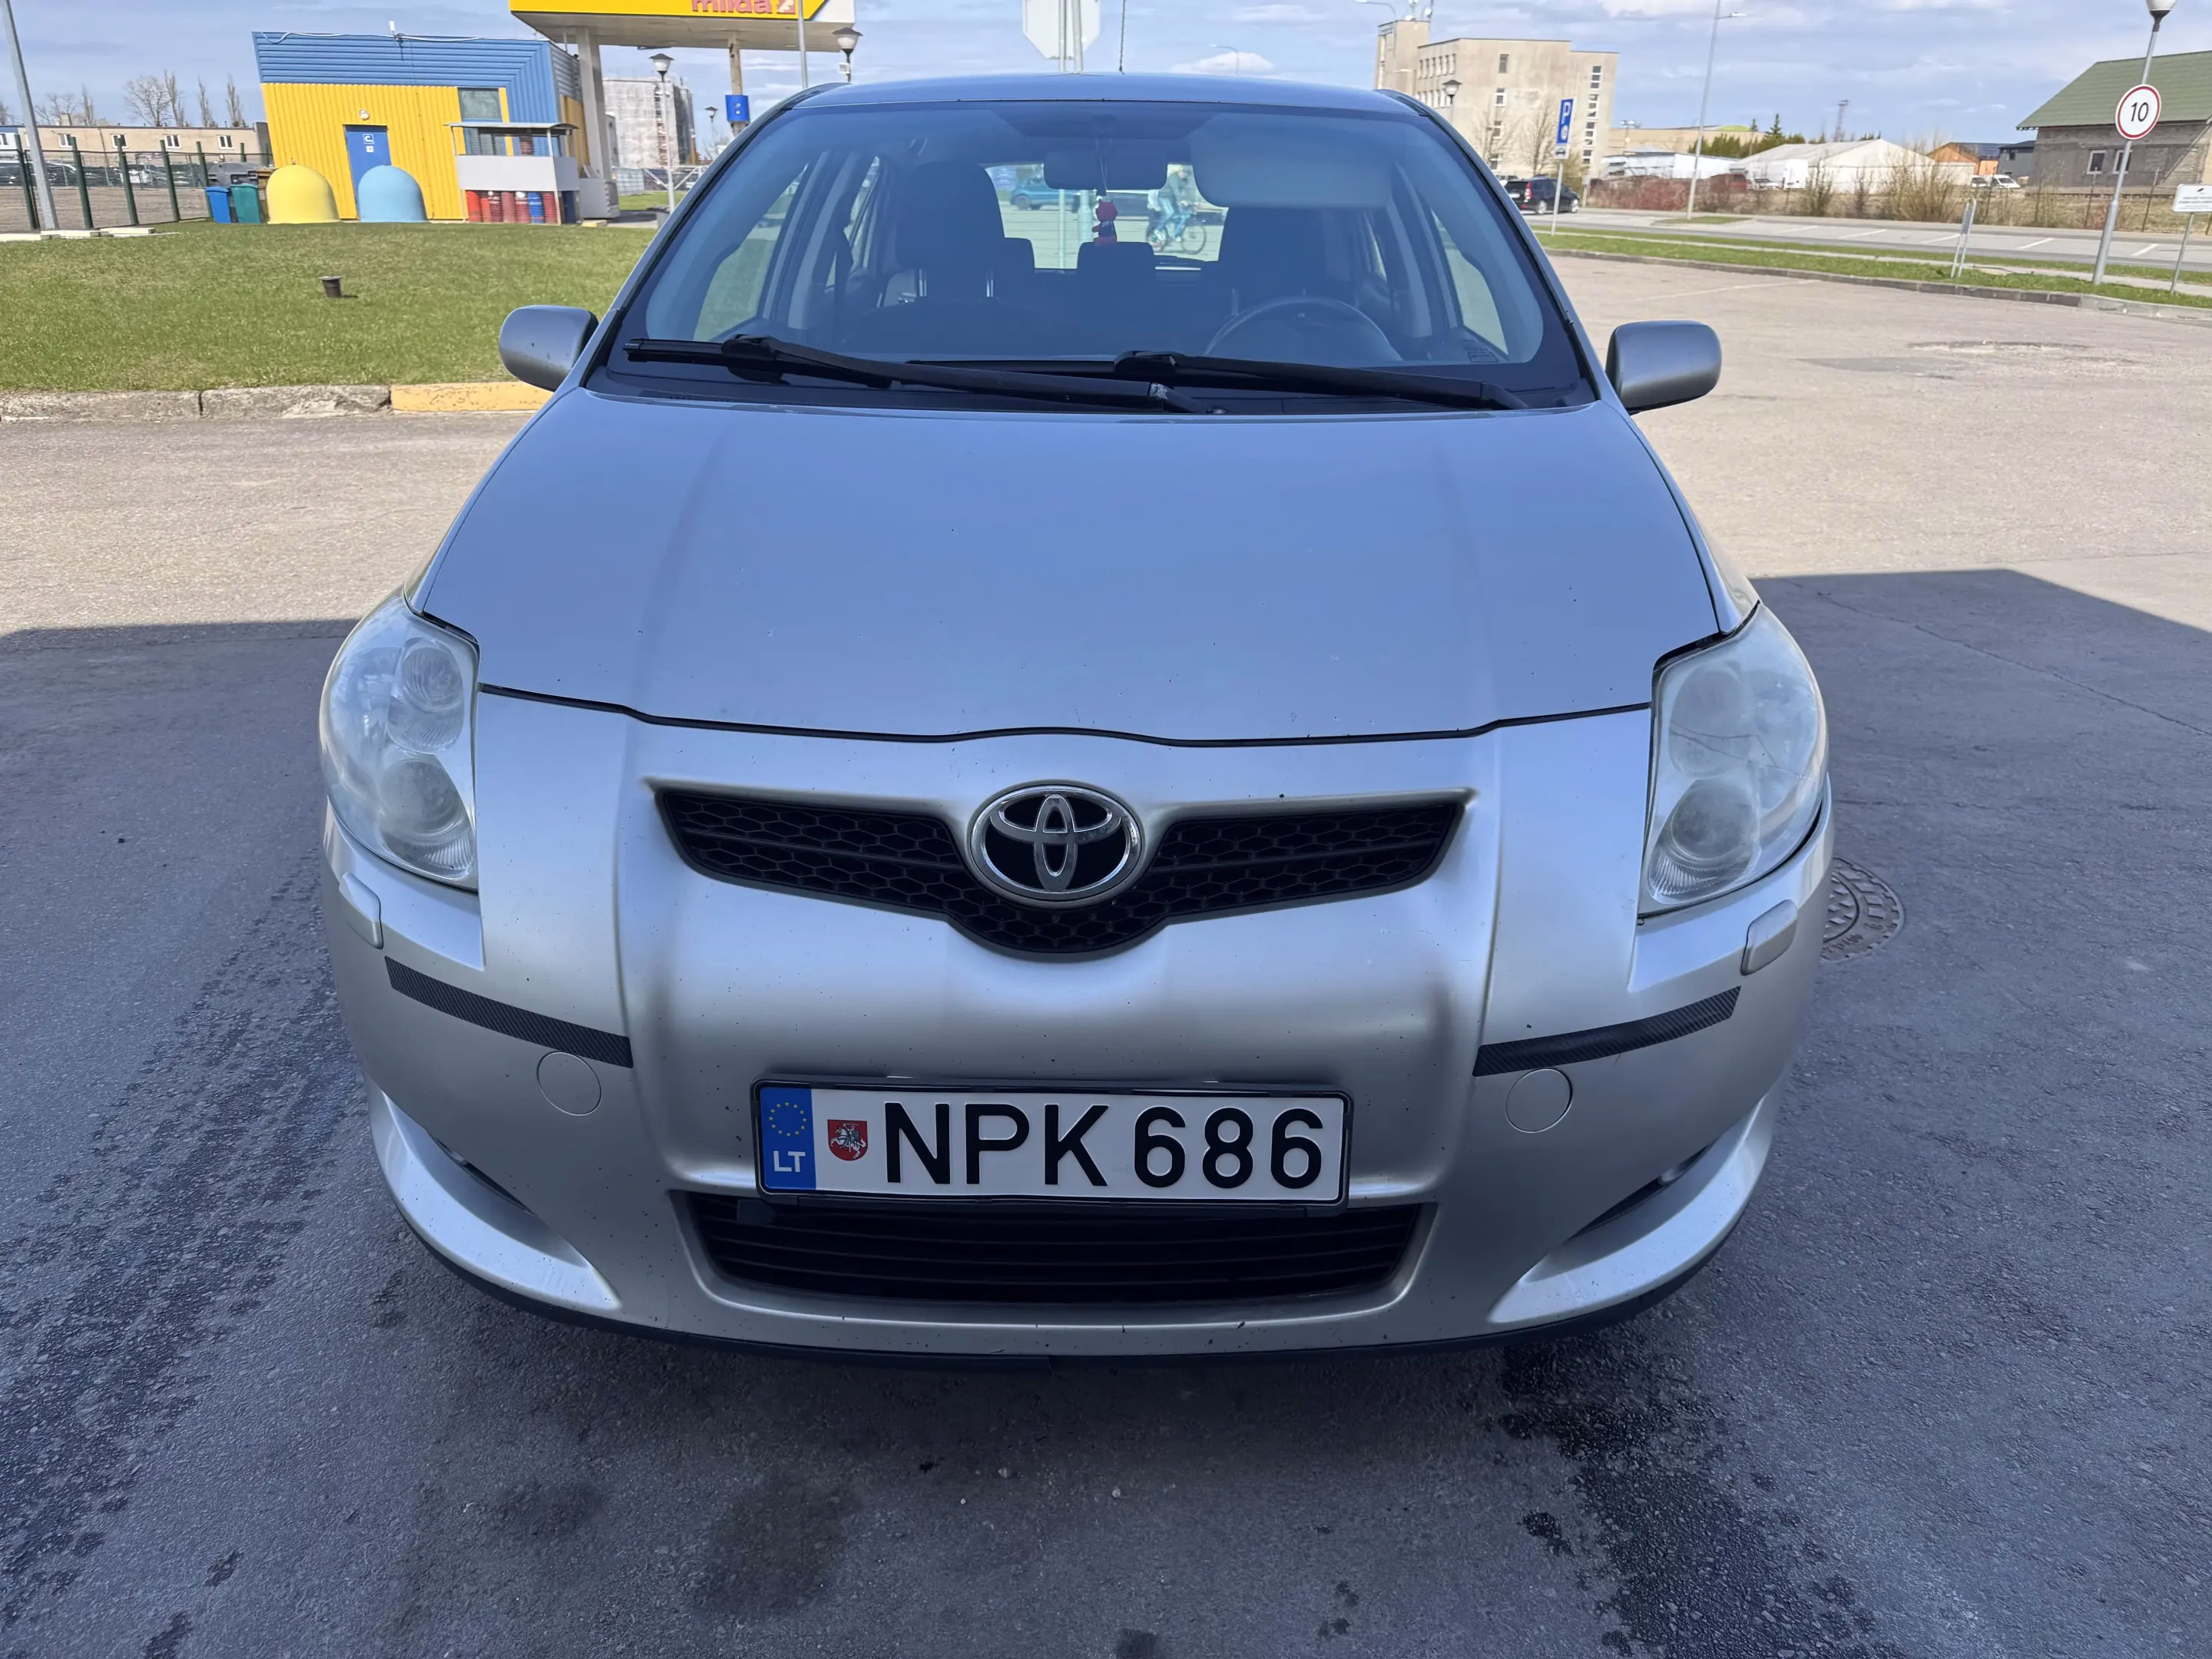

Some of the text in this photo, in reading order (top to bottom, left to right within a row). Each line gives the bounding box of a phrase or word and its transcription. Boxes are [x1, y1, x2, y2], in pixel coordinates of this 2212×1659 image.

[1561, 101, 1571, 124] P
[2131, 102, 2149, 122] 10
[885, 1101, 1323, 1189] NPK 686
[773, 1151, 806, 1173] LT
